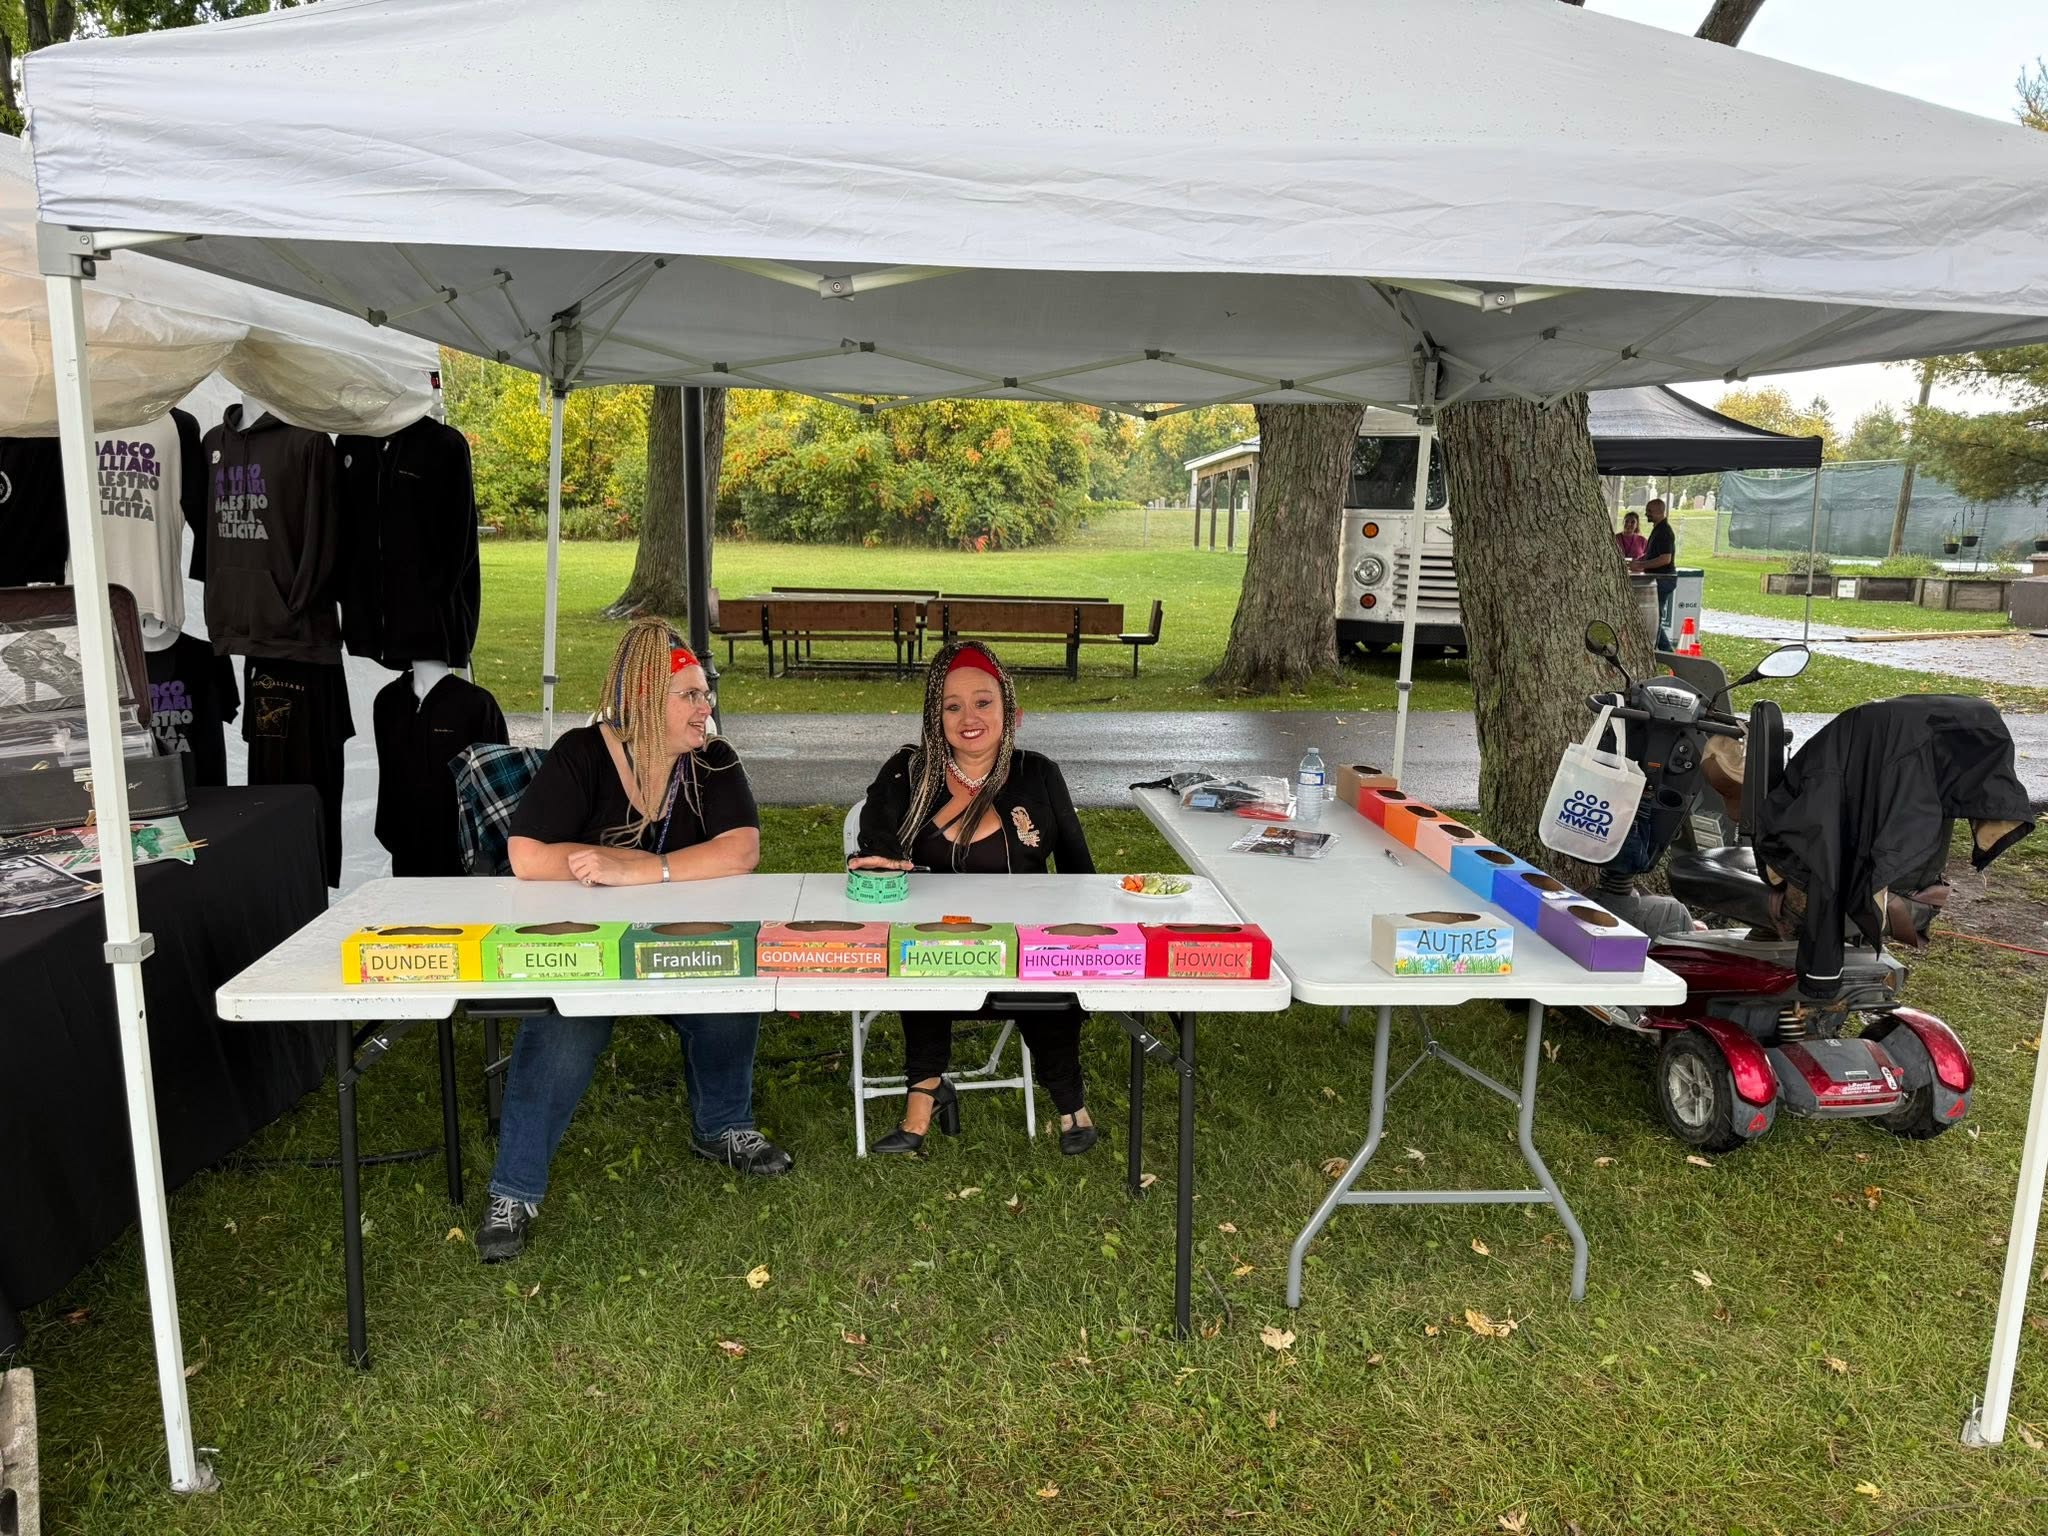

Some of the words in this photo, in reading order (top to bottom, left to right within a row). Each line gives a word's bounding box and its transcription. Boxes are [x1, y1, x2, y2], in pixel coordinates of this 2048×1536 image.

[99, 455, 160, 477] LLIARI
[98, 471, 159, 491] ESTRO
[100, 487, 143, 502] ELLA
[100, 499, 154, 521] LICITÀ
[149, 681, 185, 698] RCO
[152, 695, 192, 711] IARI
[151, 710, 193, 727] STRO
[1558, 810, 1610, 838] MWCN
[1417, 928, 1497, 954] AUTRES
[371, 954, 448, 971] DUNDEE
[525, 952, 578, 968] ELGIN
[652, 951, 722, 968] Franklin
[762, 951, 881, 965] GODMANCHESTER
[907, 950, 999, 967] HAVELOCK
[1025, 951, 1142, 968] HINCHINBROOKE
[1176, 952, 1245, 968] HOWICK
